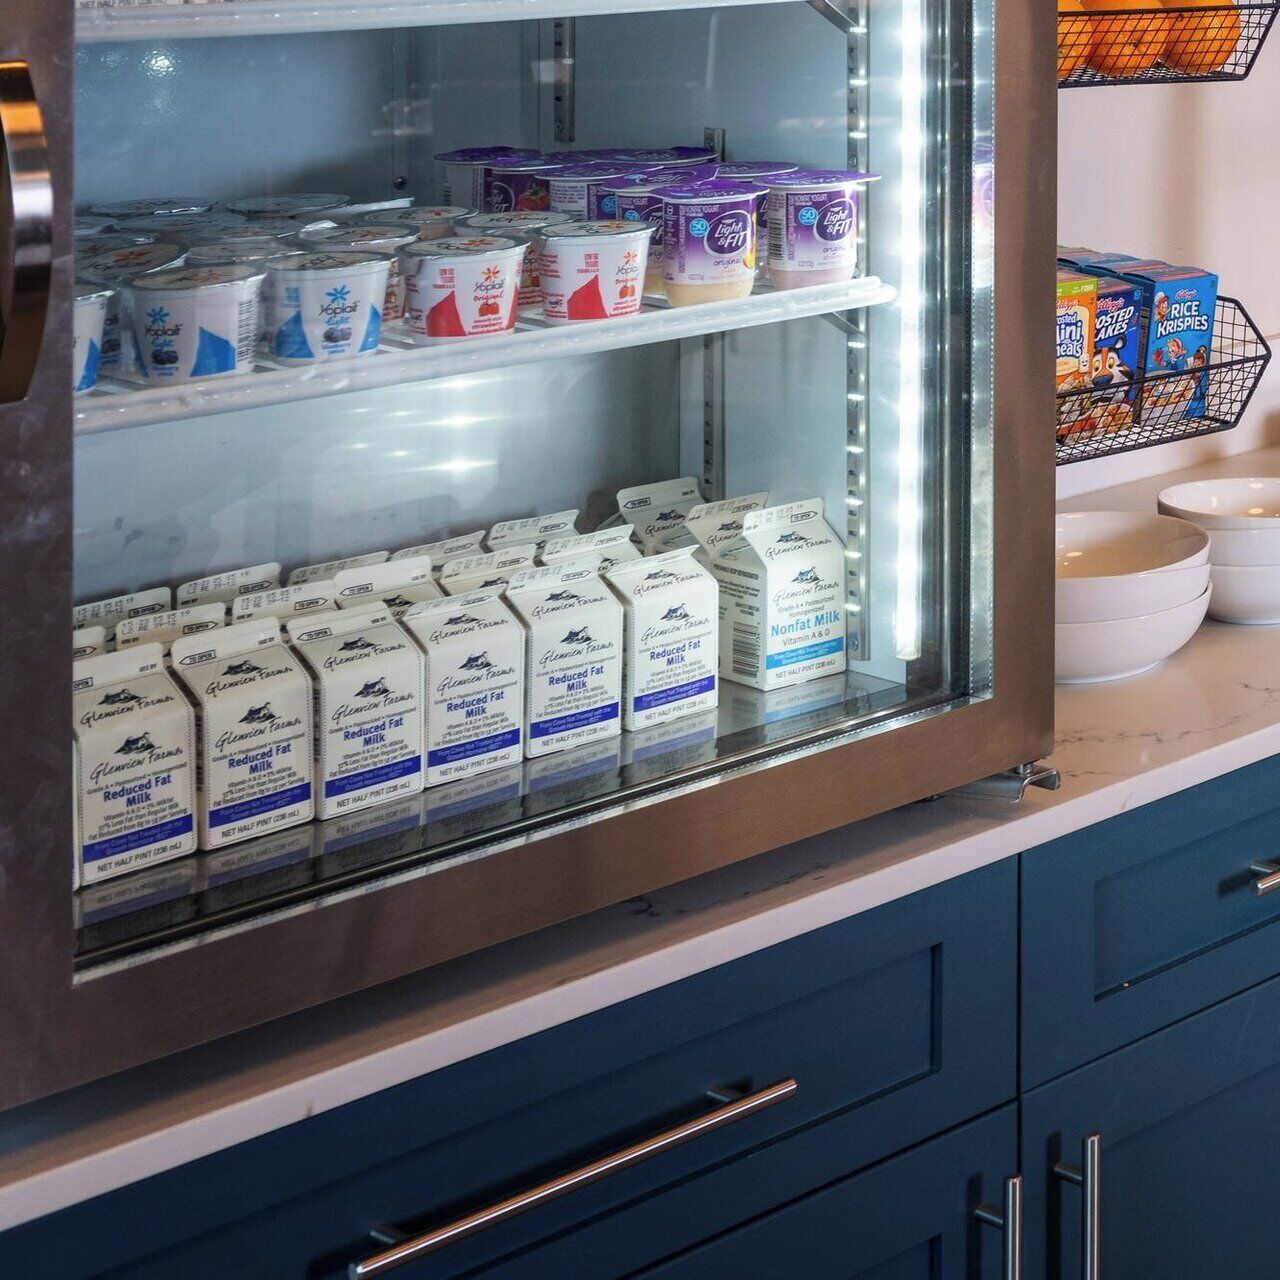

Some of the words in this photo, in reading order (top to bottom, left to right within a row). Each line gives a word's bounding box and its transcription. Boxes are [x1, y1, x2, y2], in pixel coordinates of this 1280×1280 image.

[824, 210, 848, 225] Light
[715, 222, 742, 237] Light
[833, 218, 852, 235] FIT
[725, 231, 747, 248] FIT
[318, 301, 358, 318] Yoplait
[1057, 312, 1077, 324] osted
[1096, 306, 1134, 329] OSTED
[1171, 301, 1199, 319] RICE
[145, 324, 181, 338] Yoplait
[1096, 319, 1129, 340] AKES
[1157, 315, 1208, 338] KRISPIES
[771, 618, 811, 637] Nonfat
[814, 610, 840, 627] Milk
[783, 633, 809, 646] Vitamin
[650, 644, 686, 661] Reduced
[688, 640, 701, 650] Fat
[667, 654, 685, 666] Milk
[549, 668, 588, 686] Reduced
[590, 666, 604, 677] Fat
[567, 679, 587, 692] Milk
[447, 693, 488, 712] Reduced
[490, 691, 504, 702] Fat
[465, 705, 487, 719] Milk
[343, 720, 385, 741] Reduced
[389, 717, 404, 729] Fat
[363, 733, 386, 747] Milk
[542, 739, 554, 747] NET
[228, 747, 273, 769] Reduced
[276, 743, 292, 756] Fat
[249, 760, 273, 775] Milk
[440, 767, 453, 776] NET
[454, 763, 470, 773] HALF
[471, 759, 485, 768] PINT
[104, 780, 151, 801] Reduced
[155, 775, 172, 787] Fat
[126, 792, 152, 807] Milk
[337, 798, 351, 808] NET
[352, 793, 368, 803] HALF
[370, 788, 385, 798] PINT
[222, 827, 236, 838] NET
[237, 823, 255, 833] HALF
[256, 817, 272, 828] PINT
[98, 862, 112, 873] NET
[115, 857, 132, 868] HALF
[135, 851, 151, 863] PINT
